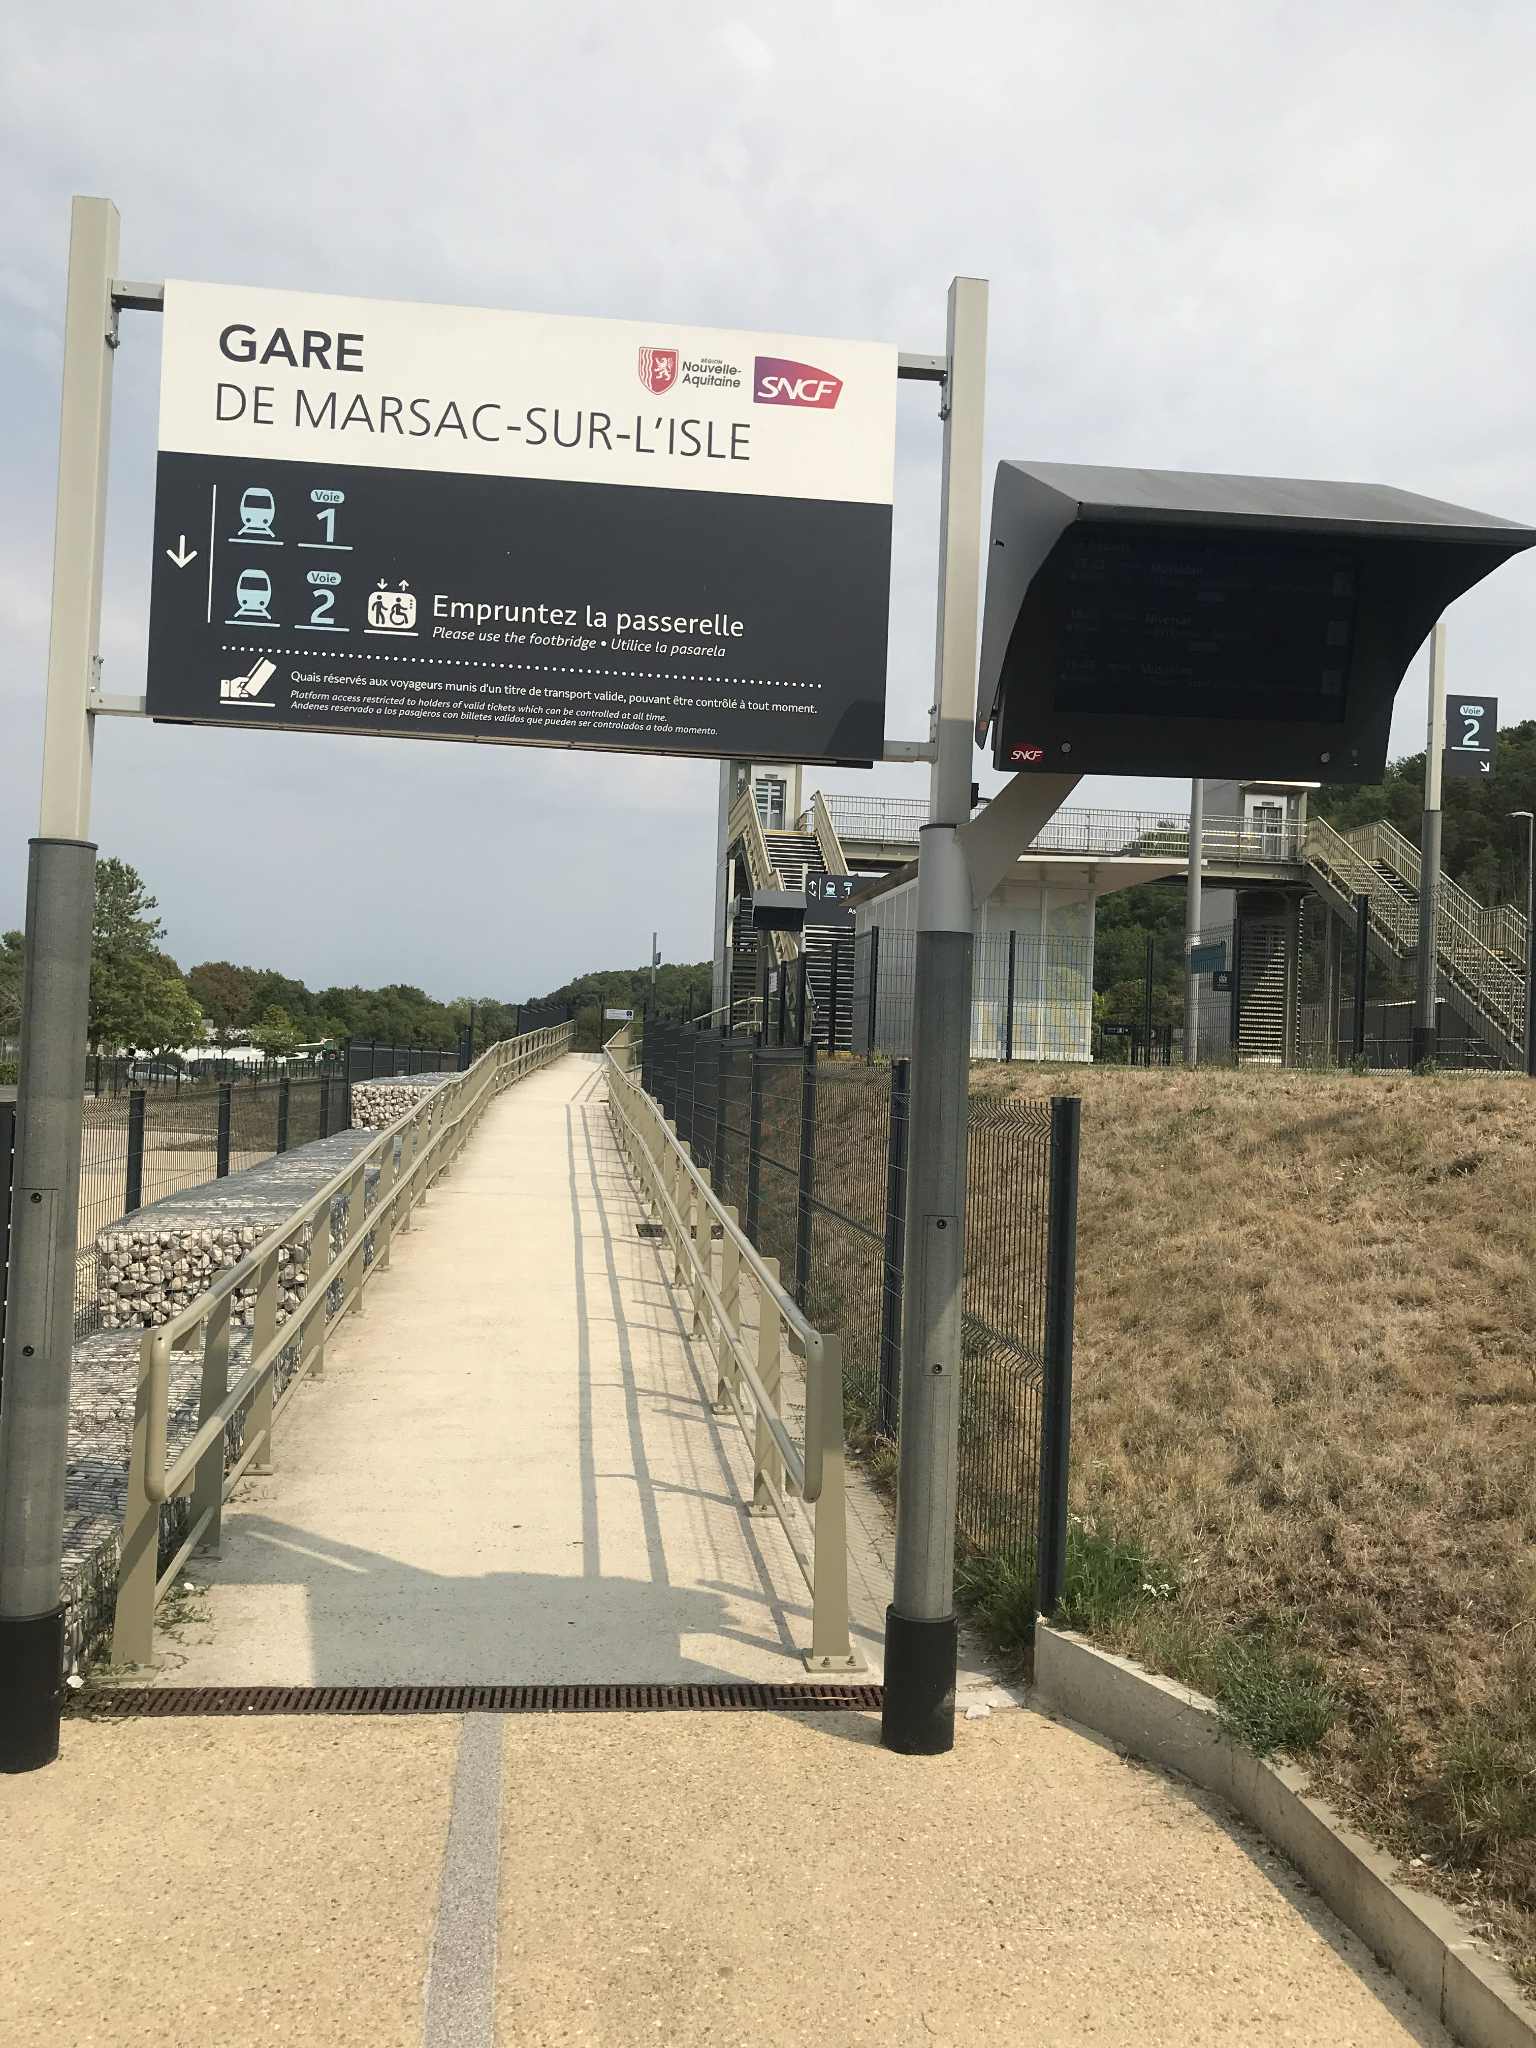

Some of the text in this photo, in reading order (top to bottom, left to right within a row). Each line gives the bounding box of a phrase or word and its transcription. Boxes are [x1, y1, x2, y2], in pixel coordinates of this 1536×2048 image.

[219, 324, 364, 372] GARE
[682, 361, 742, 375] Nouvelle-
[682, 373, 741, 388] Aquitaine
[757, 376, 837, 401] SNCF
[216, 382, 750, 460] DE MARSAC-SUR-L'ISLE
[314, 491, 340, 502] Voie
[316, 508, 335, 542] 1
[311, 572, 337, 583] Voie
[310, 588, 335, 624] 2
[433, 594, 744, 637] Empruntez la passerelle
[432, 626, 726, 657] Please use the footbridge Utilice la pasarela
[290, 670, 818, 714] Quais réservés aux voyageurs munis d'un titre de transport valide, pouvant être contrôlé à tout moment.
[290, 690, 668, 722] Platform access restricted to holders of valid tickets which can be controlled at all time.
[290, 700, 329, 711] Andenes
[330, 703, 374, 714] reservado
[384, 706, 397, 716] los
[398, 708, 441, 719] pasajeros
[442, 711, 459, 719] con
[460, 711, 492, 721] billetes
[494, 713, 525, 723] validos
[526, 717, 543, 726] que
[544, 717, 577, 727] pueden
[578, 720, 592, 728] ser
[592, 719, 644, 731] controlados
[653, 722, 673, 732] todo
[675, 725, 718, 735] momento.
[1463, 706, 1481, 715] Voie
[1462, 719, 1480, 746] 2
[1010, 750, 1043, 760] SNCF
